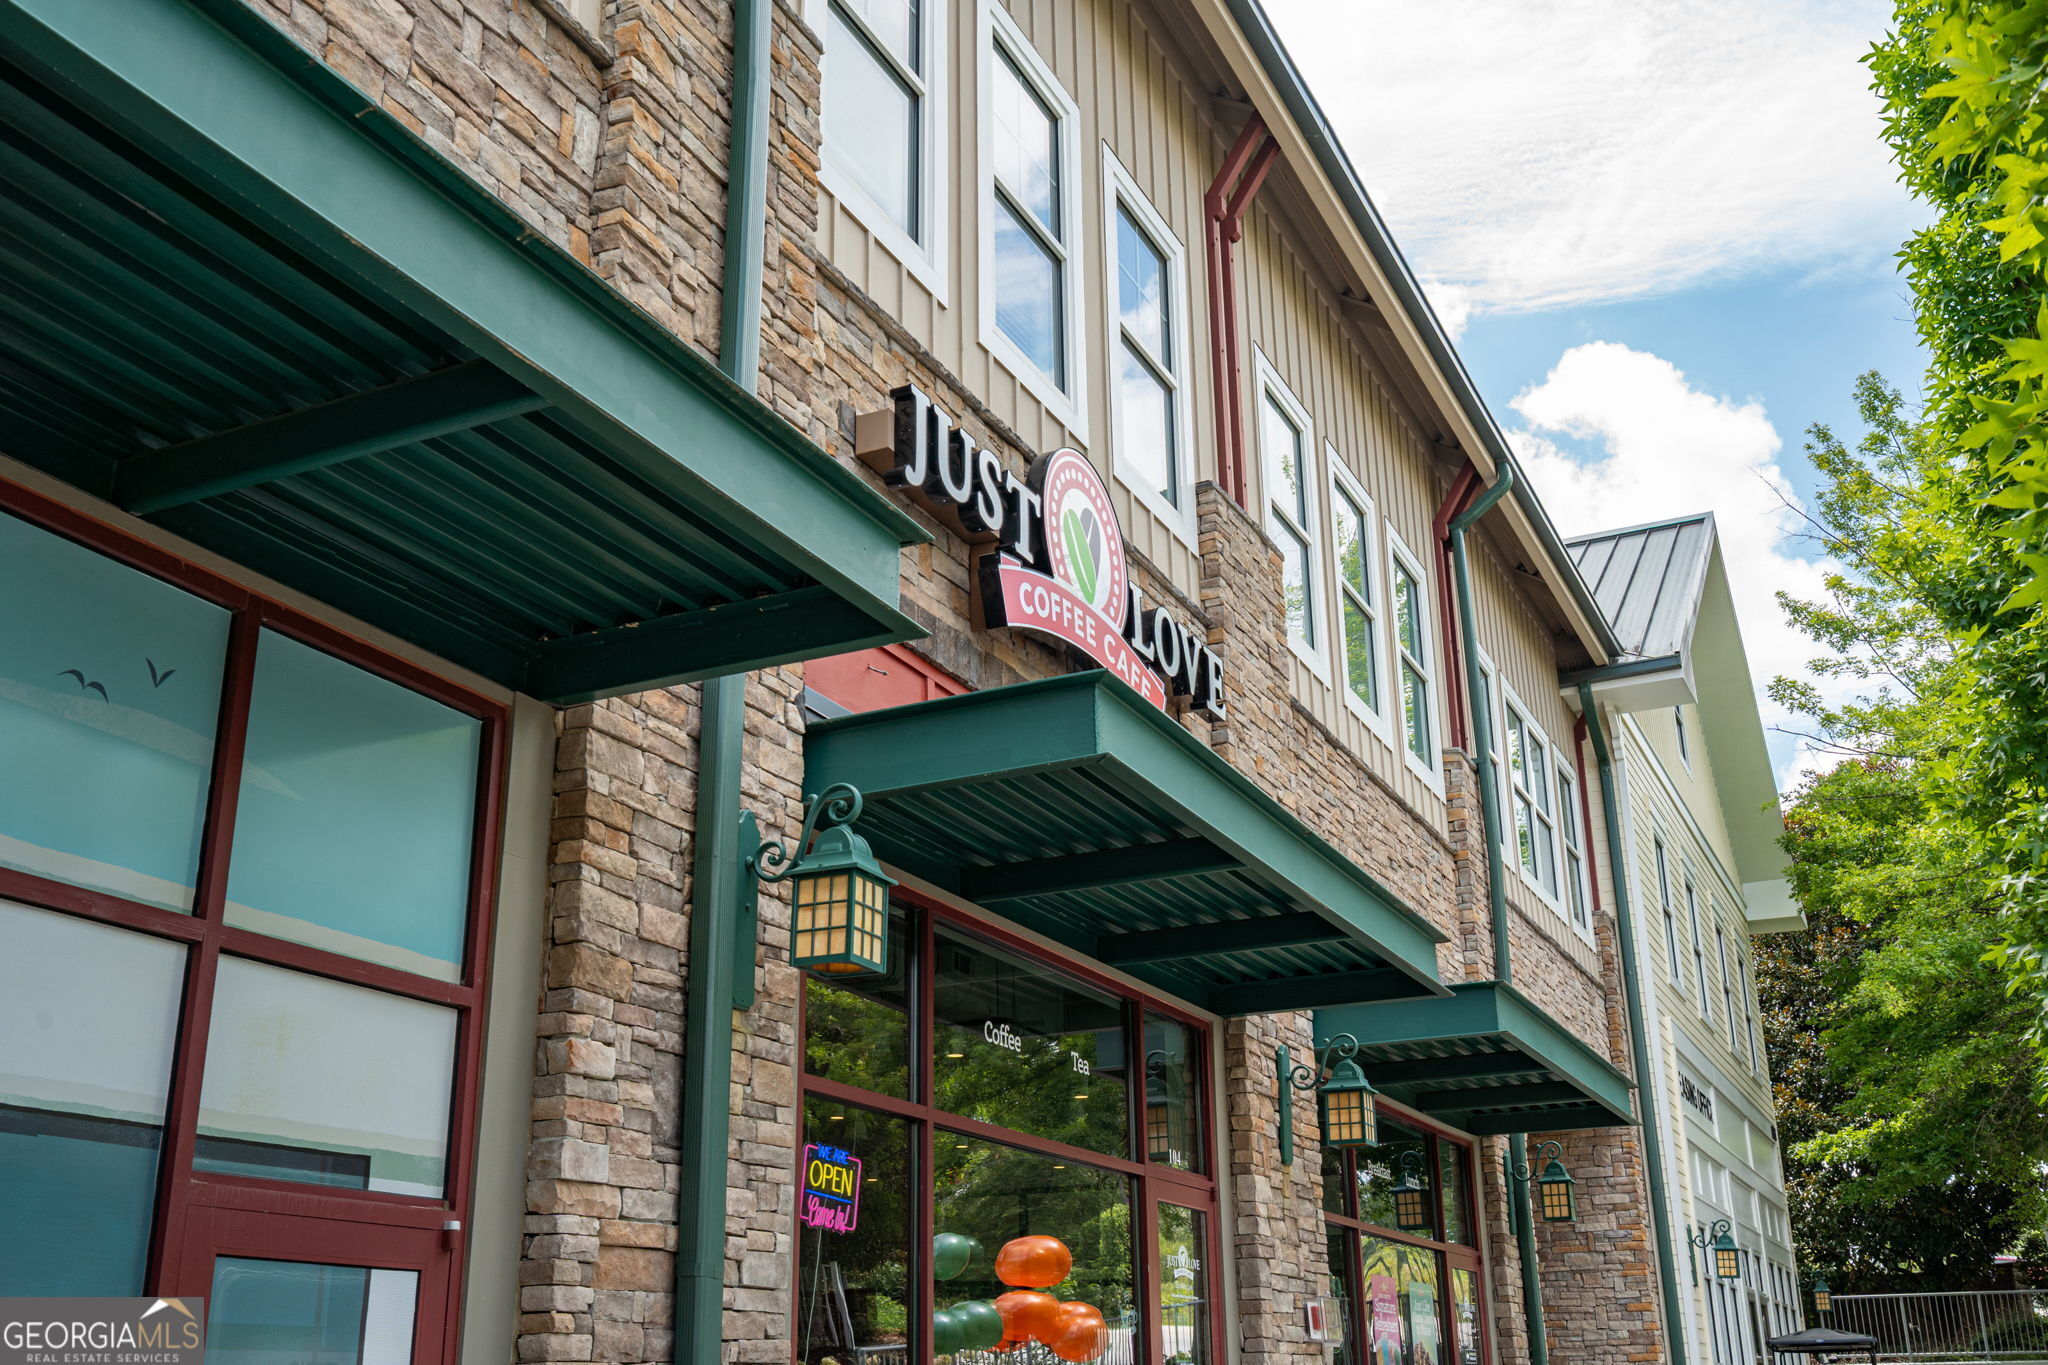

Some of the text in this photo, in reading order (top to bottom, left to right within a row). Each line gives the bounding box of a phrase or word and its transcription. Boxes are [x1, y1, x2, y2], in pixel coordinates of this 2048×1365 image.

[904, 384, 1042, 565] JUST
[1019, 582, 1151, 698] COFFEE CAFE
[1129, 581, 1227, 722] LOVE
[984, 1020, 1022, 1052] Coffee
[1070, 1051, 1090, 1076] Tea
[817, 1141, 849, 1165] WE ARE
[1169, 1149, 1181, 1166] 104
[810, 1160, 854, 1197] OPEN
[808, 1194, 836, 1228] Come
[1166, 1254, 1180, 1268] JUST
[1188, 1258, 1201, 1271] LOVE
